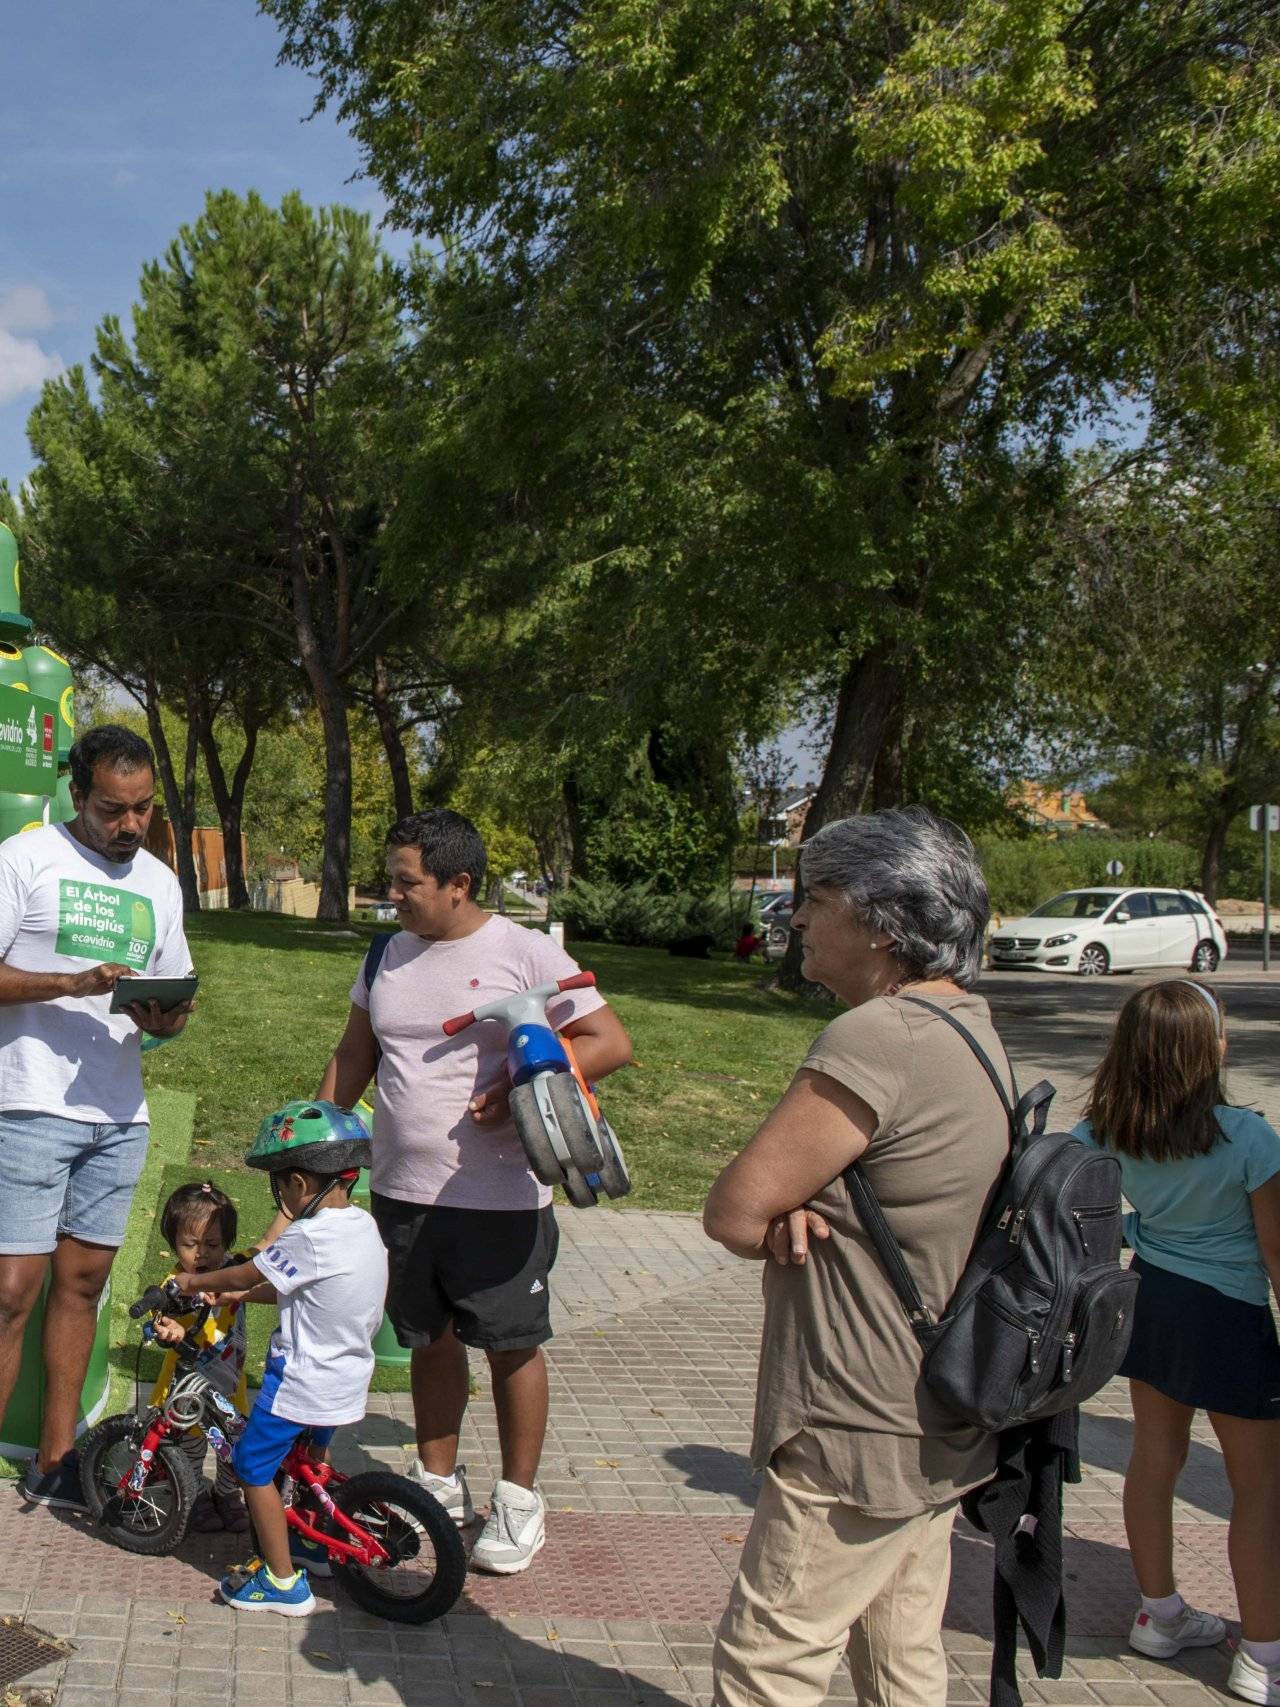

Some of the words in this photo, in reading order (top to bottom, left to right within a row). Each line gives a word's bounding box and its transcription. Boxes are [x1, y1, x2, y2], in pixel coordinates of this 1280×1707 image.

[66, 886, 80, 898] El
[83, 886, 120, 906] Árbol
[73, 900, 92, 913] de
[96, 903, 115, 918] los
[65, 912, 125, 934] Miniglús
[71, 933, 115, 949] ecovidrio
[128, 941, 148, 955] 100
